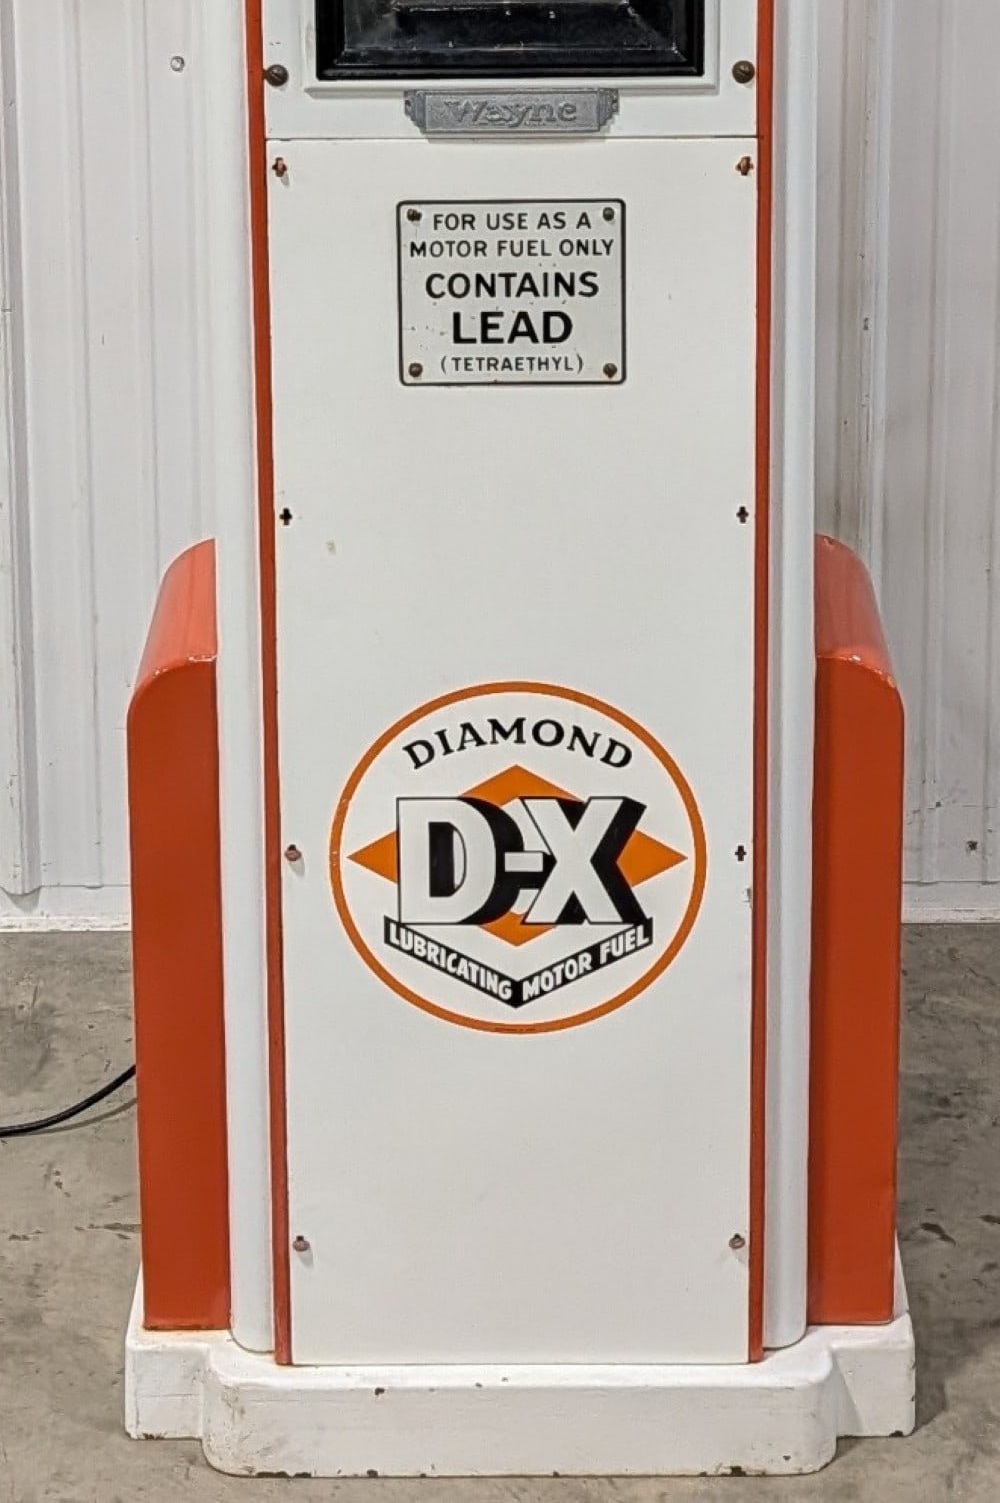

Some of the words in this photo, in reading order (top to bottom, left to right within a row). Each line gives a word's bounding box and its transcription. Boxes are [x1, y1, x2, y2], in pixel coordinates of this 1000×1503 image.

[444, 99, 578, 128] Wayne
[433, 213, 476, 231] FOR
[486, 213, 528, 230] USE
[537, 212, 566, 229] AS
[576, 212, 592, 229] A
[410, 240, 488, 258] MOTOR
[497, 239, 552, 257] FUEL
[558, 239, 614, 256] ONLY
[425, 271, 600, 299] CONTAINS
[452, 310, 573, 345] LEAD
[440, 353, 584, 374] (TETRAETHYL)
[402, 717, 633, 770] DIAMOND
[396, 795, 647, 925] D-X
[389, 921, 512, 1001] LUBRICATING
[522, 954, 592, 1001] MOTOR
[600, 924, 650, 965] FUEL
